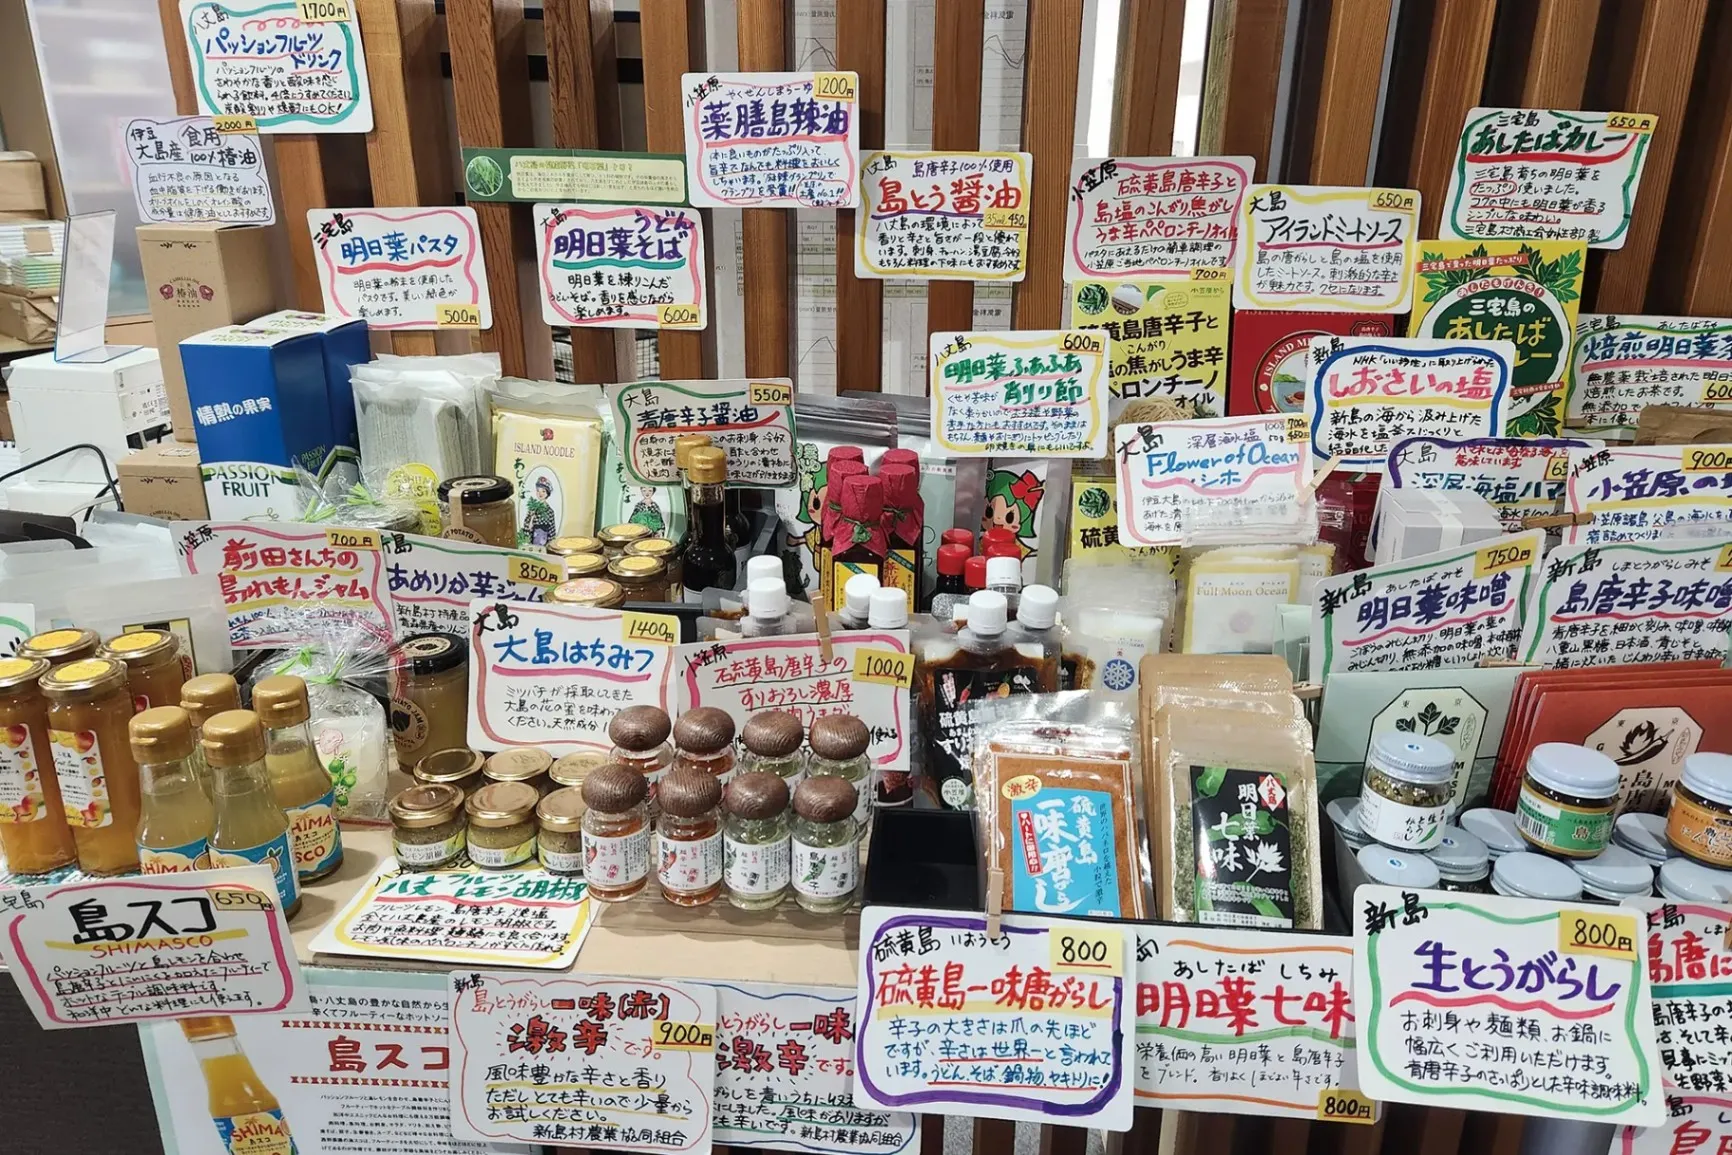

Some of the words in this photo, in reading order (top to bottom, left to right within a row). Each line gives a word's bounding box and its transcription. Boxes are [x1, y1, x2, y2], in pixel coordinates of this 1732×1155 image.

[194, 5, 230, 34] 八丈島
[206, 27, 324, 55] パッションフルーツ
[290, 50, 343, 71] ドリンク
[686, 75, 723, 107] 小笠原
[816, 77, 855, 96] 1200円
[701, 97, 850, 140] 薬膳島辣油
[1496, 110, 1541, 128] 三宅島
[1608, 114, 1652, 129] 650円
[130, 127, 158, 141] 伊豆
[1470, 120, 1628, 156] あしたばカレー
[136, 141, 186, 162] 大島産
[861, 155, 898, 180] 八丈島
[1071, 158, 1120, 203] 小笠原
[1474, 165, 1602, 182] 三宅島育ちの明日葉を
[876, 172, 1023, 215] 島とう醤油
[1117, 168, 1238, 197] 硫黄島唐辛子と
[1472, 182, 1581, 197] たっぷり使いました。
[1093, 195, 1235, 225] 島塩のこんがり焦がし
[1248, 189, 1288, 216] 大島
[1375, 192, 1414, 208] 650円
[314, 210, 355, 250] 三宅島
[540, 208, 569, 230] 大島
[633, 209, 696, 234] うどん
[1260, 212, 1404, 245] アイランドミートソース
[339, 229, 460, 264] 明日葉パスタ
[553, 226, 690, 261] 明日葉そば
[1256, 247, 1404, 267] 島の唐がらしと島の塩を使用
[566, 270, 673, 290] 明日葉を練りこんだ
[1192, 267, 1228, 281] 700円
[356, 305, 403, 319] 楽しめます。
[443, 308, 479, 325] 500円
[572, 305, 631, 320] 楽しめます。
[662, 305, 699, 325] 600円
[1468, 296, 1537, 317] 三宅島の
[1444, 315, 1553, 347] あしたば
[1576, 315, 1621, 335] 三宅島
[934, 335, 972, 366] 八丈島
[1063, 333, 1100, 352] 600円
[1127, 339, 1167, 354] こんがり
[1312, 337, 1346, 366] 新島
[753, 387, 792, 402] 550円
[1003, 377, 1084, 406] 削り節
[1328, 366, 1495, 400] しおさいの塩
[1583, 385, 1685, 400] 焙煎したお茶です。
[624, 388, 660, 409] 大島
[1174, 392, 1216, 407] オイル
[196, 396, 273, 428] 情熱の果実
[637, 402, 759, 431] 青唐辛子醤油
[1330, 406, 1483, 427] 新島の海から汲み上げた
[513, 442, 543, 456] ISLAND
[543, 445, 576, 459] NOODLE
[1116, 425, 1165, 465] 大島
[1187, 427, 1262, 450] 深層海水塩
[1146, 450, 1223, 477] Flower
[1224, 446, 1245, 465] of
[1246, 442, 1301, 465] Ocean
[1397, 442, 1438, 468] 大島
[1571, 449, 1615, 479] 小笠原
[208, 464, 281, 485] PASSION
[222, 481, 270, 498] FRUIT
[178, 524, 219, 557] 小笠原
[331, 532, 374, 547] 700円
[222, 537, 360, 572] 前田さんちの
[1483, 546, 1531, 571] 750円
[1547, 547, 1603, 584] 新島
[520, 561, 559, 583] 850円
[1318, 572, 1373, 619] 新島
[1356, 570, 1513, 634] 明日葉味噌
[473, 602, 520, 637] 大島
[628, 619, 675, 643] 1400円
[493, 627, 655, 673] 大島はちみつ
[680, 643, 734, 679] 小笠原
[866, 655, 909, 685] 1000円
[506, 684, 635, 702] ミツバチが採取してきた
[1237, 782, 1261, 842] 明日葉
[379, 873, 443, 897] 八丈
[214, 892, 275, 912] 650円
[1364, 891, 1429, 937] 新島
[69, 897, 218, 945] 島スコ
[90, 934, 214, 959] SHIMASCO
[873, 926, 942, 962] 硫黄島
[1573, 919, 1633, 951] 800円
[1060, 936, 1108, 963] 800
[453, 972, 485, 994] 新島
[1173, 960, 1267, 981] あしたば
[1410, 939, 1622, 1001] 生とうがらし
[875, 960, 1113, 1012] 硫黄島一味唐がらし
[1136, 976, 1356, 1040] 明日葉七味
[660, 1021, 713, 1047] 900円
[888, 1015, 1098, 1041] 辛子の大きさは爪の先ほど
[1399, 1009, 1612, 1043] お刺身や麺類、お鍋に
[328, 1034, 449, 1074] 島スコ
[884, 1037, 1112, 1068] ですが、辛さは世界一と言われて
[1404, 1035, 1612, 1081] 幅広くご利用いただけます。
[484, 1063, 667, 1089] 風味豊かな辛さと香り
[485, 1088, 693, 1115] ただしとても辛いので少量から
[486, 1103, 609, 1123] お試しください。
[1323, 1096, 1371, 1119] 800円
[532, 1123, 688, 1148] 新島村農業協同組合
